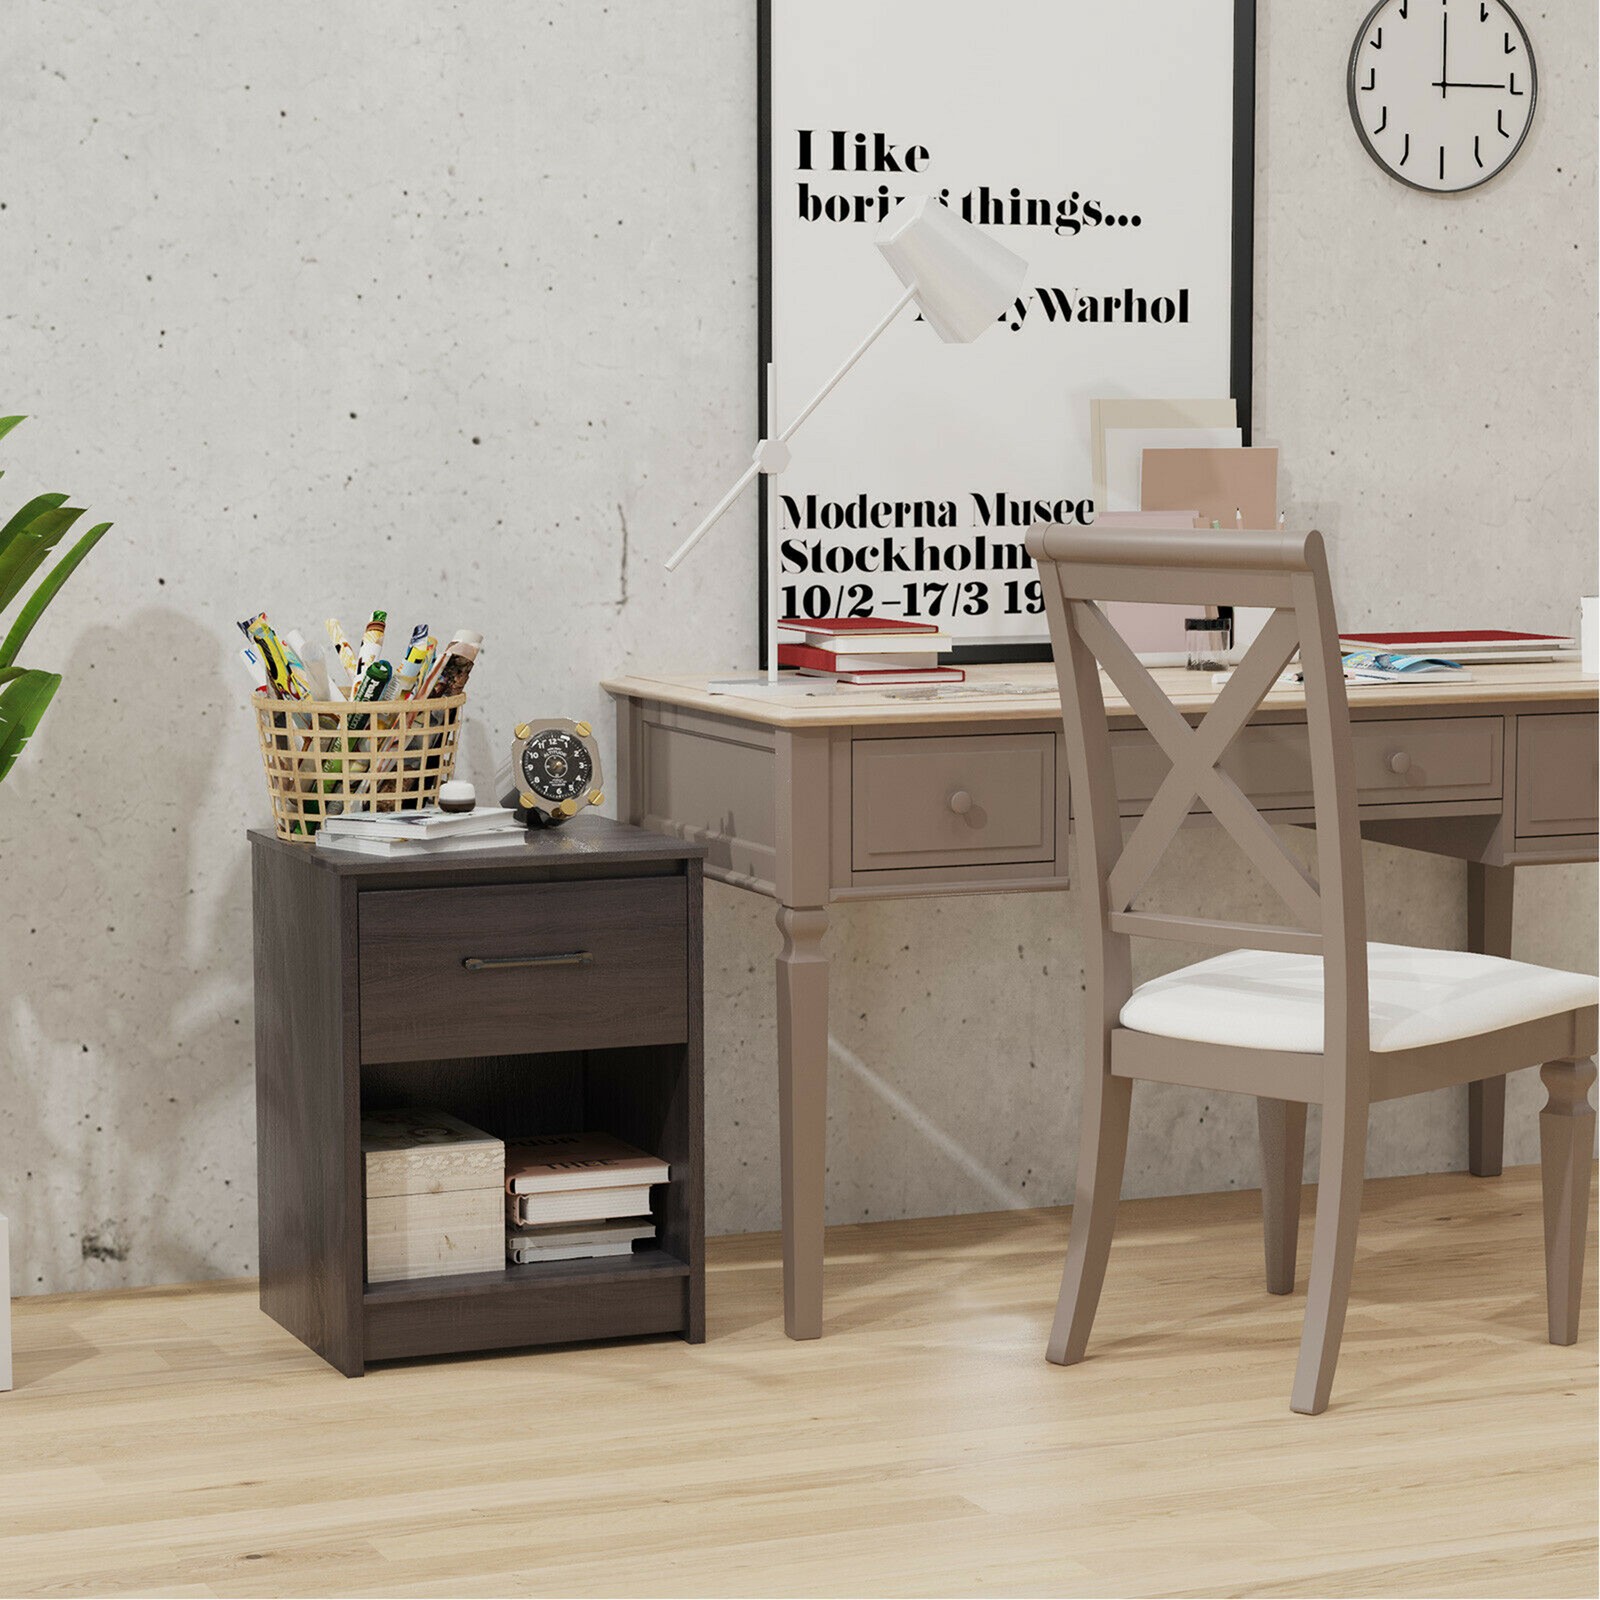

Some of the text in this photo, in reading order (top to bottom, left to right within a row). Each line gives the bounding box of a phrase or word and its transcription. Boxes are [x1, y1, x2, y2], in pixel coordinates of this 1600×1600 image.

[795, 129, 931, 173] I like
[796, 182, 949, 223] bori
[1034, 287, 1190, 324] Warhol
[779, 492, 1095, 530] Moderna Musee
[780, 535, 1034, 574] Stockholm
[543, 785, 549, 793] 7
